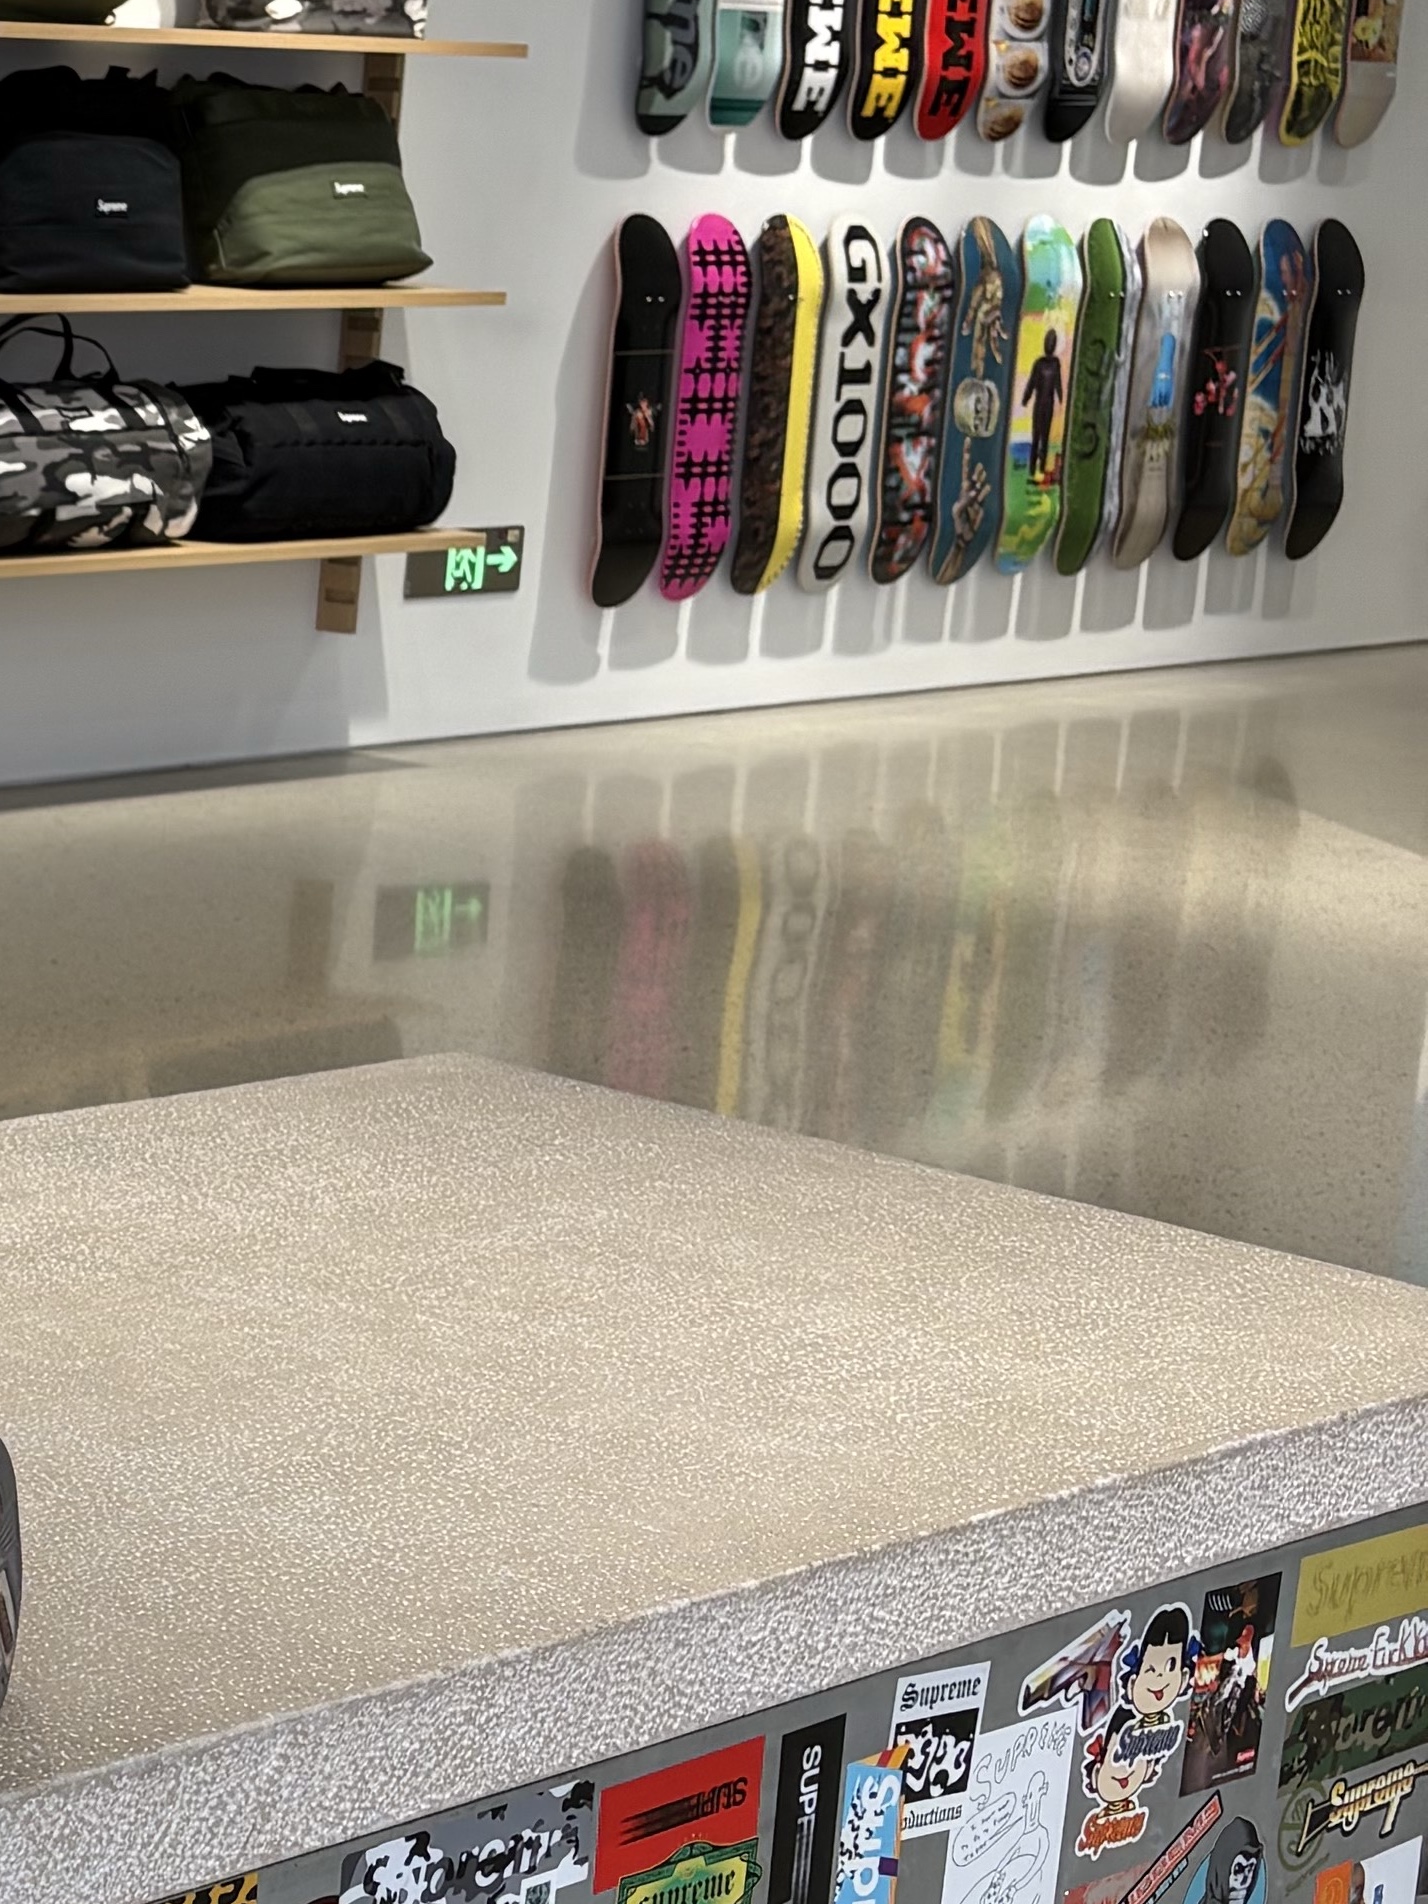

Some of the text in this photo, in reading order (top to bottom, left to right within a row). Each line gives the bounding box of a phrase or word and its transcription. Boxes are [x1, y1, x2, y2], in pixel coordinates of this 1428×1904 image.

[813, 224, 882, 581] GX1000
[900, 1674, 983, 1712] Supreme
[901, 1801, 964, 1836] oductions
